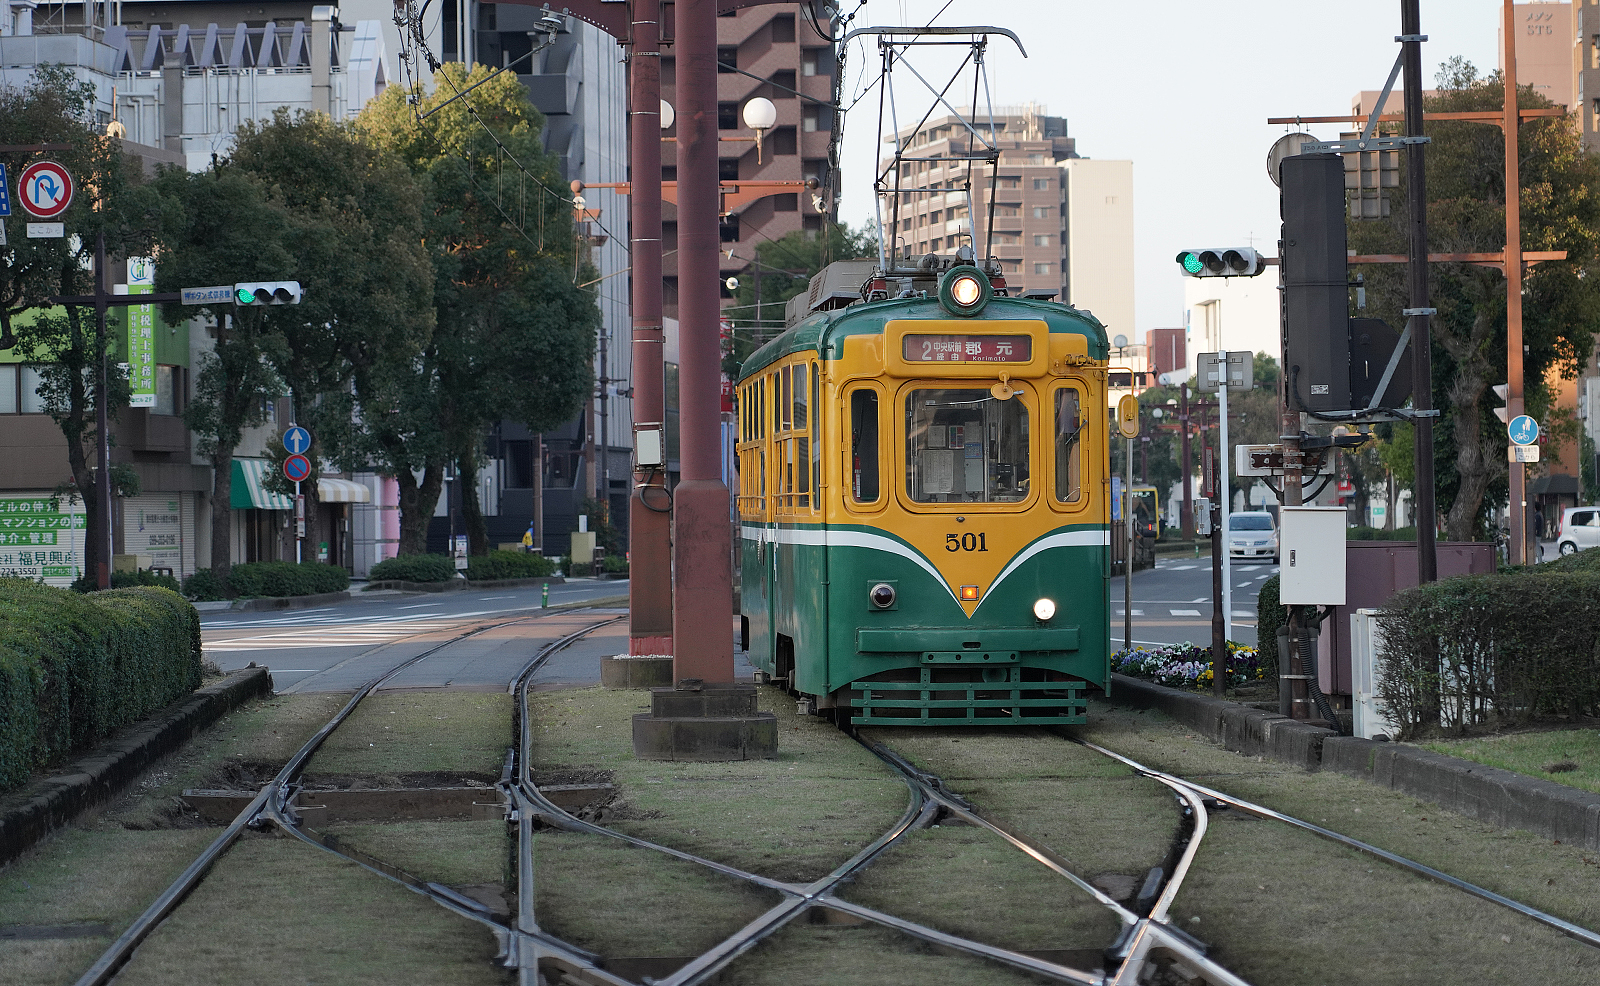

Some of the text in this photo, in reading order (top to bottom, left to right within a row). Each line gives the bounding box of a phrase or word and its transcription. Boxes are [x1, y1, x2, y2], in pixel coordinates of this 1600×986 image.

[28, 226, 62, 235] ここから
[921, 341, 932, 361] 2
[933, 342, 962, 353] 中央駅前
[936, 353, 960, 361] 経由
[945, 532, 989, 552] 501
